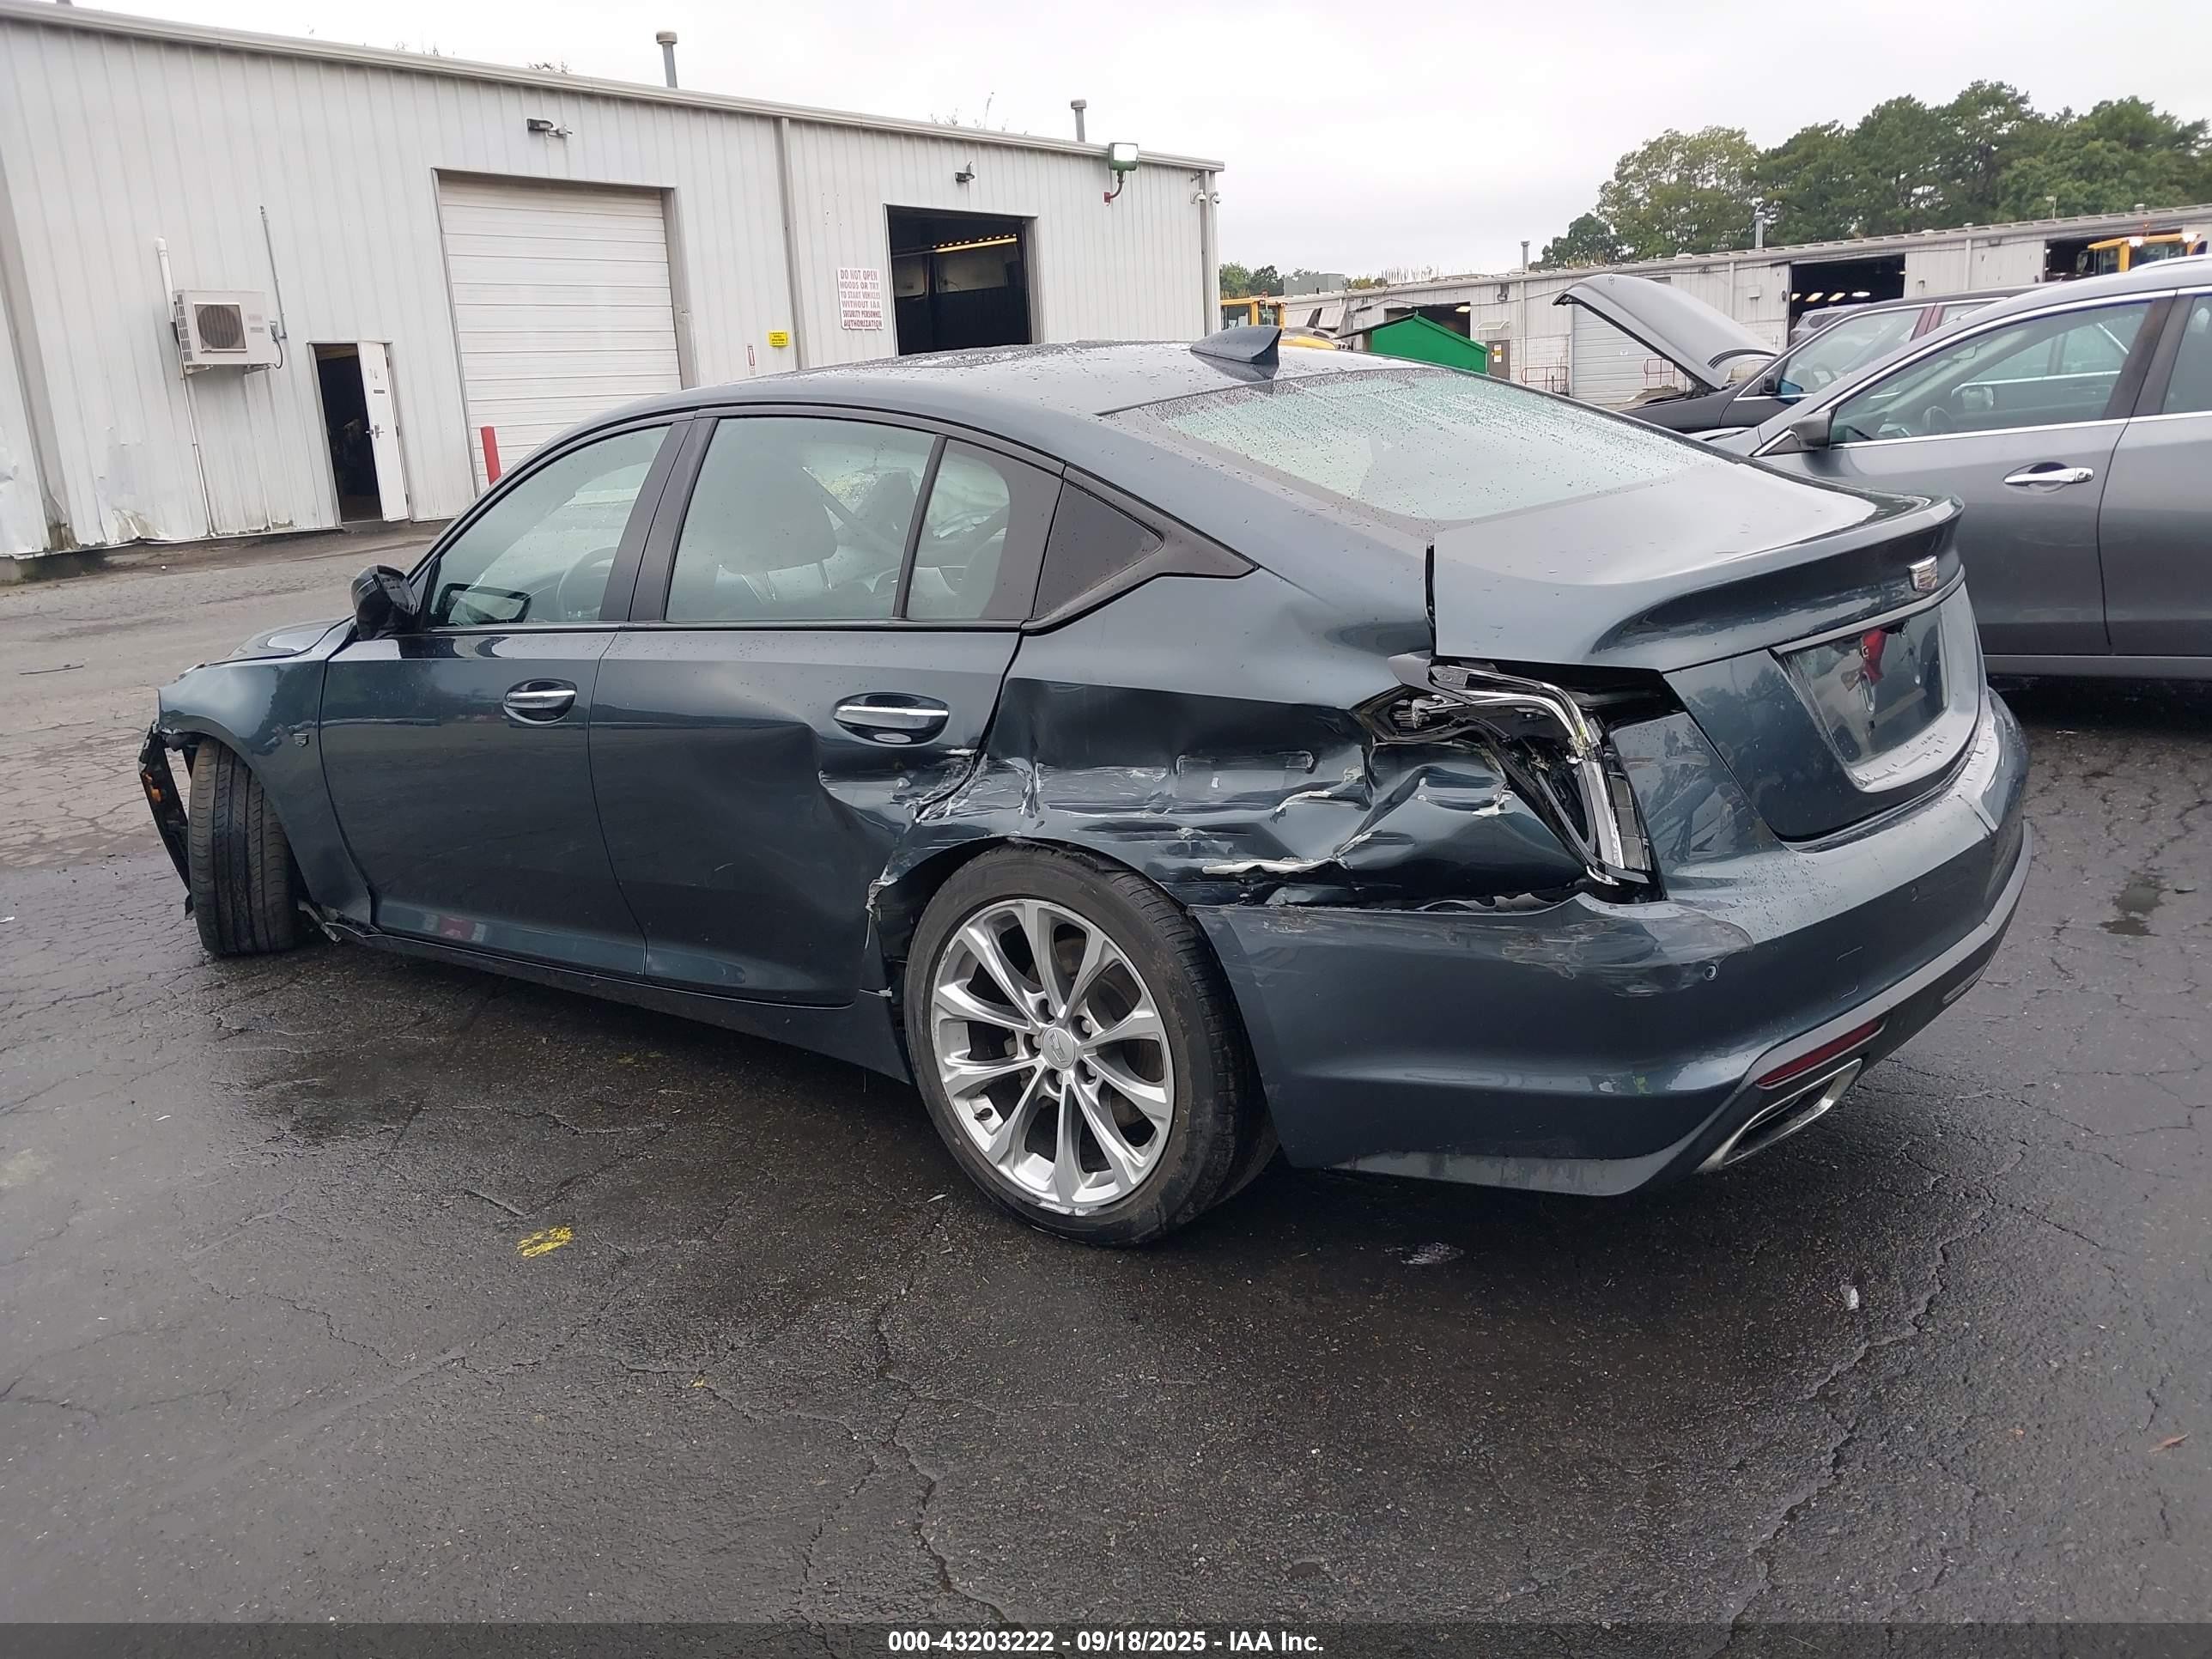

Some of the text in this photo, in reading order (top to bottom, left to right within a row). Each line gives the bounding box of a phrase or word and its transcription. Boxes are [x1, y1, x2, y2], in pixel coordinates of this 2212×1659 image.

[840, 269, 878, 281] DO NOT OPEN
[840, 281, 879, 290] HOODS OR TRY
[862, 291, 881, 300] VEHICLES
[870, 301, 881, 309] IAA
[843, 310, 860, 319] SECURITY
[843, 319, 883, 328] AUTHORIZATION
